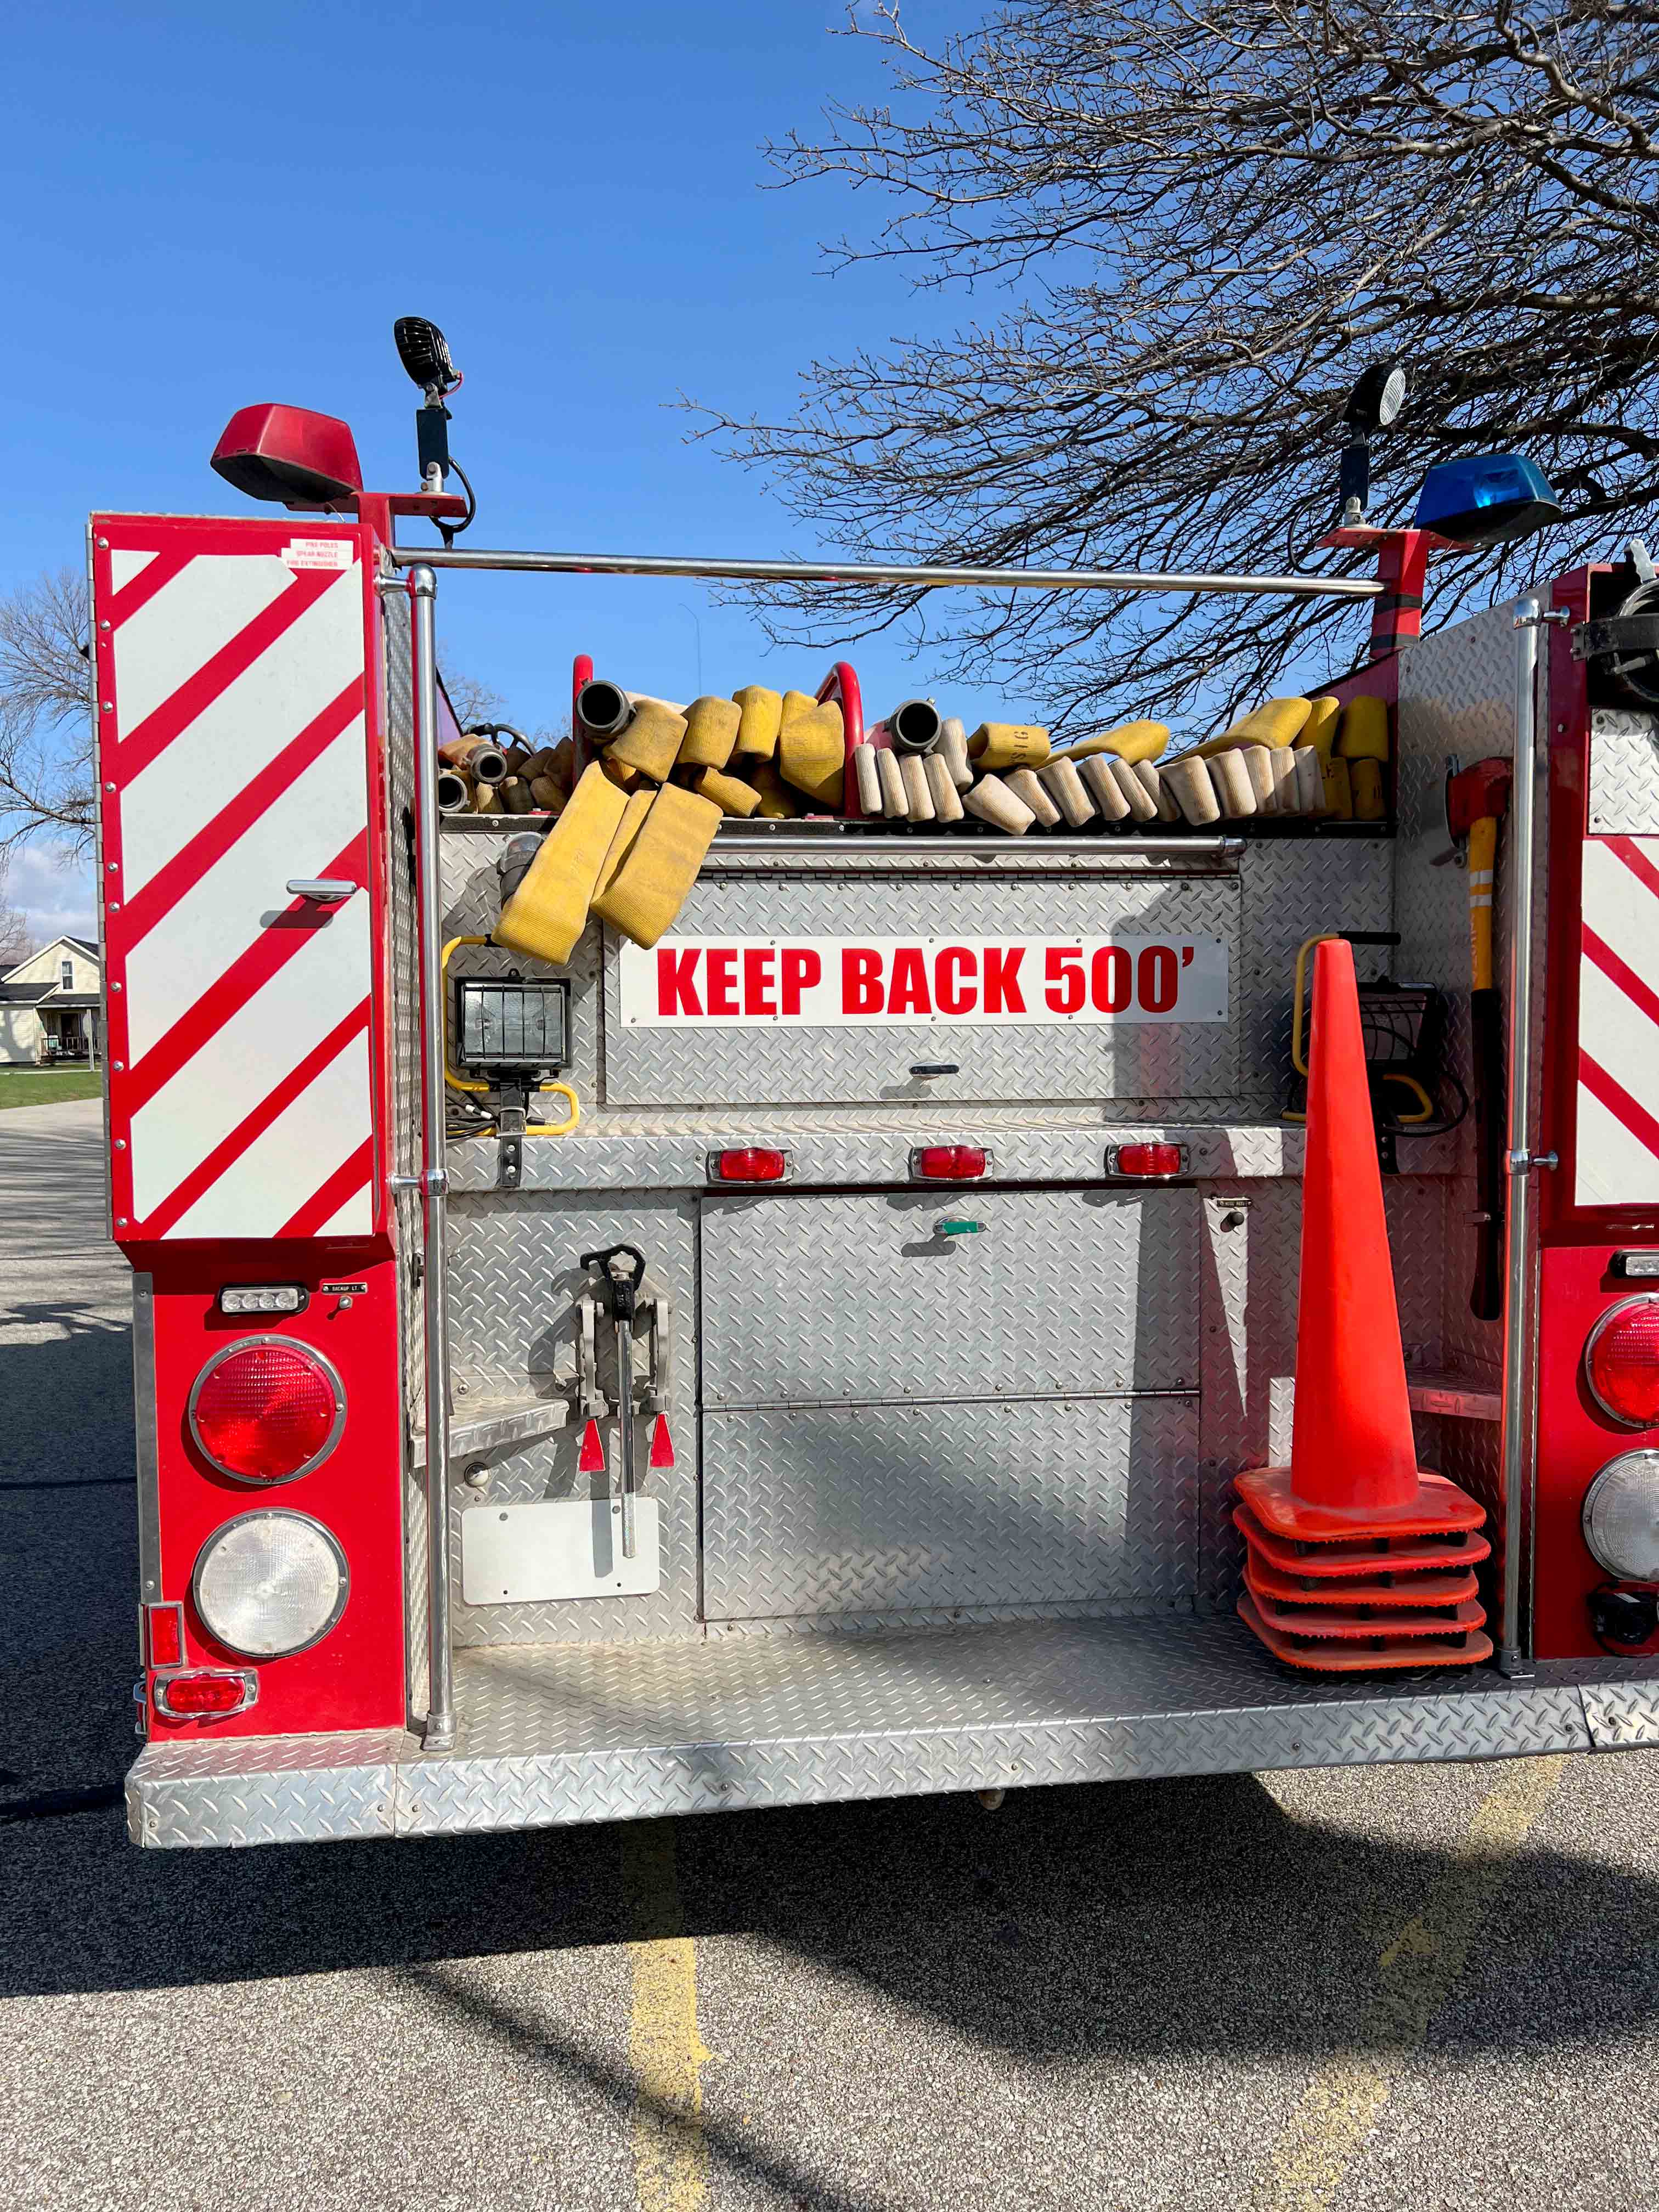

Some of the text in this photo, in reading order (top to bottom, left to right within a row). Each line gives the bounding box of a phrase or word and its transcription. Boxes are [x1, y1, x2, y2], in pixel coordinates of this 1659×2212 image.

[657, 945, 1194, 1016] KEEP BACK 500'
